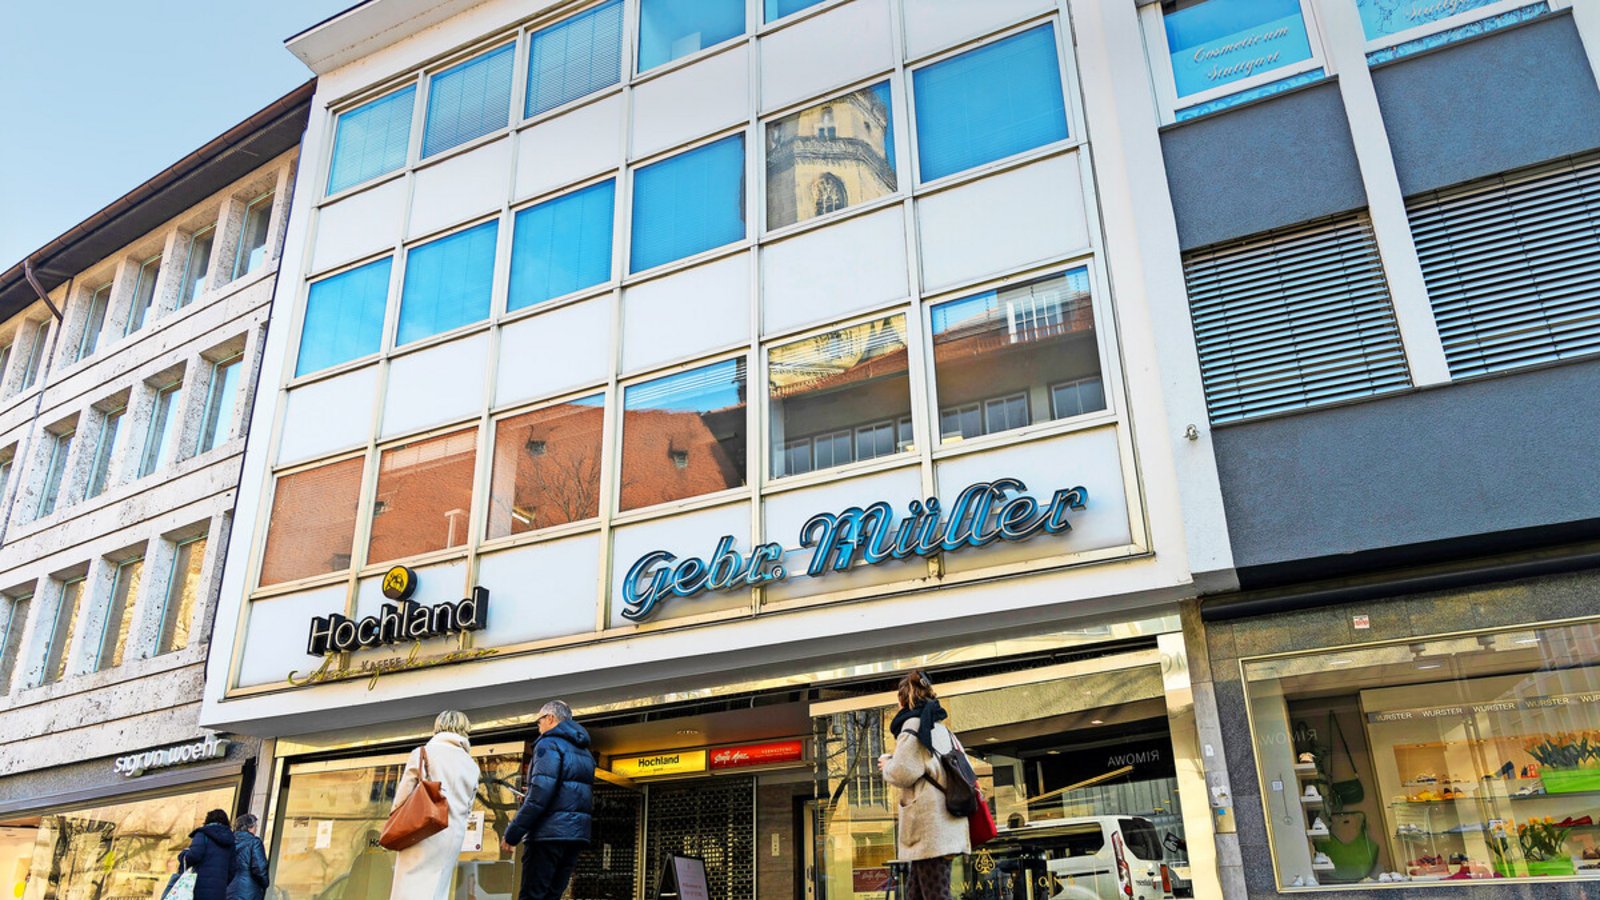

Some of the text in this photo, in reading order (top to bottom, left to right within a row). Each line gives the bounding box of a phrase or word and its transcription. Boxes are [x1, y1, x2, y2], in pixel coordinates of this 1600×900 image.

[1207, 49, 1280, 81] Stuttgart
[620, 478, 1089, 622] Gebr. Müller
[307, 586, 490, 657] Hochland
[1422, 707, 1463, 718] WURSTER
[1472, 702, 1516, 713] WURSTER
[168, 732, 232, 765] woehr
[637, 754, 680, 768] Hochland
